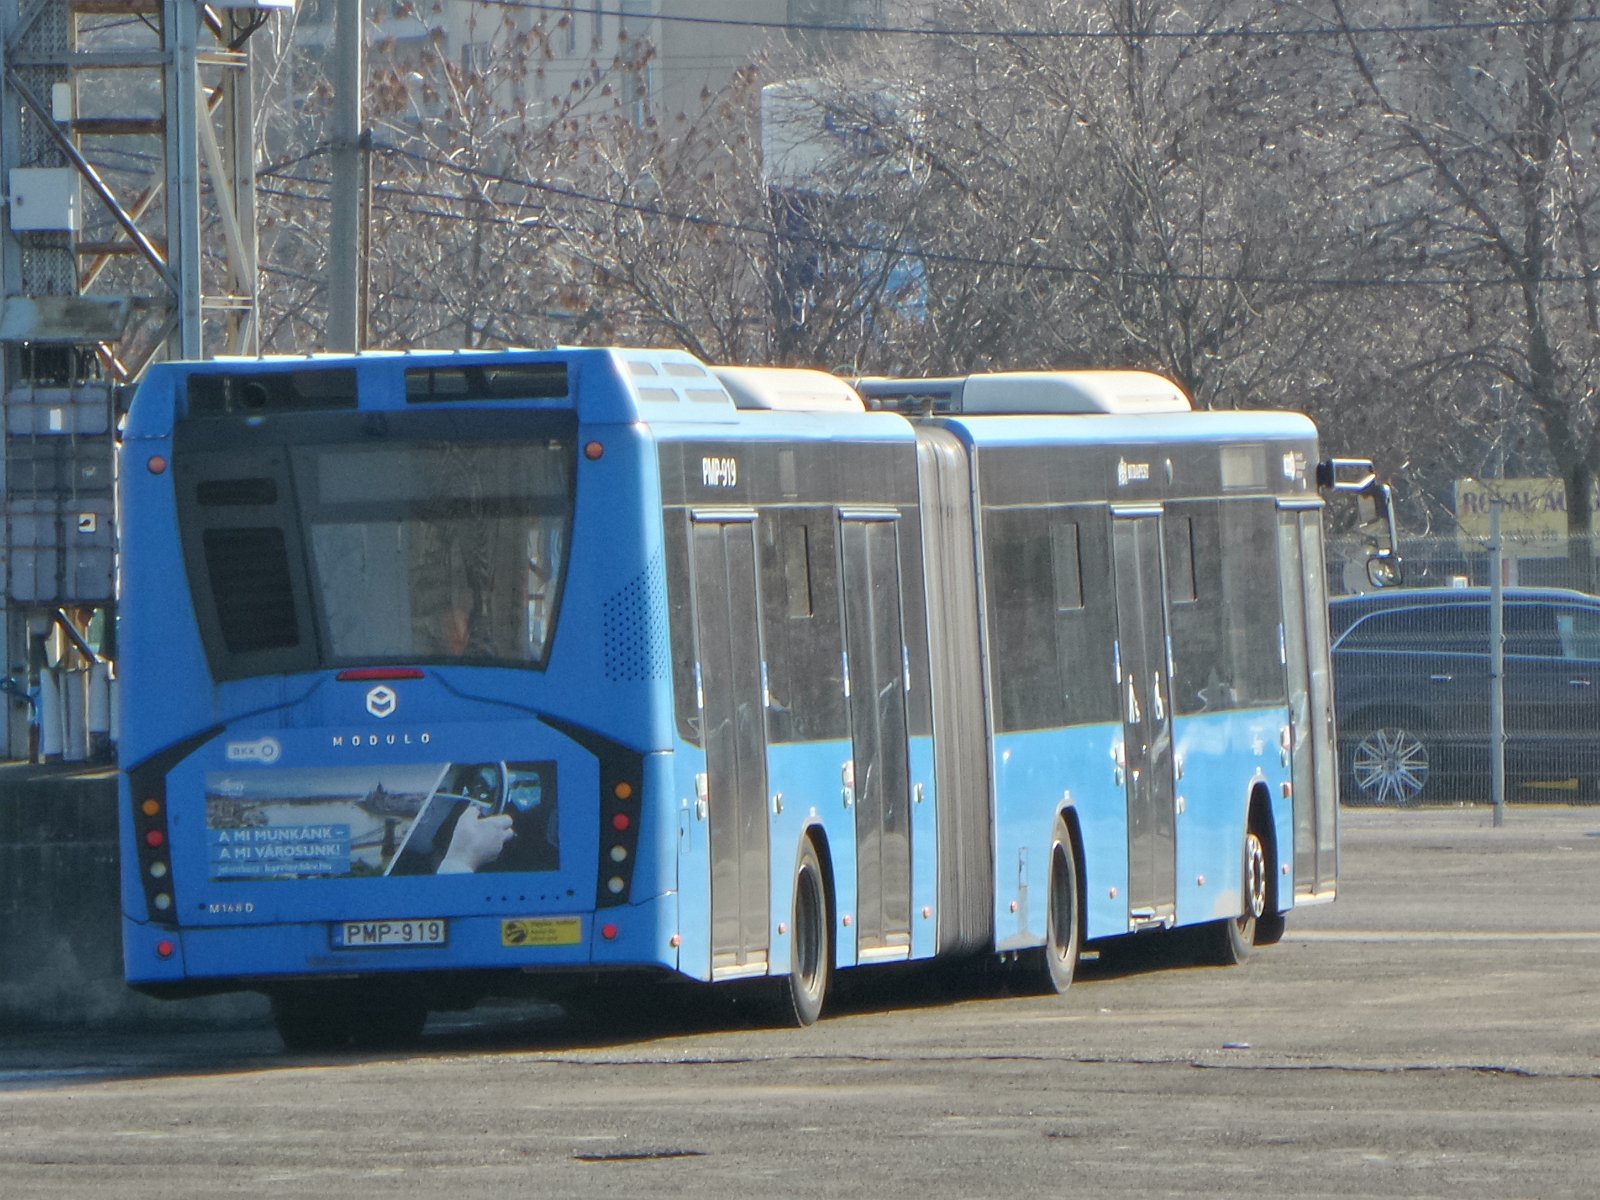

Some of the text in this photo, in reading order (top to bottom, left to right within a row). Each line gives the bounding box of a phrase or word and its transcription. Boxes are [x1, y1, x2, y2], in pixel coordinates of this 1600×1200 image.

[702, 457, 737, 487] PMP-919
[333, 733, 430, 747] MODULO
[219, 831, 230, 842] A
[234, 830, 251, 842] MI
[220, 847, 231, 859] A
[234, 846, 251, 858] MI
[347, 922, 440, 943] PMP-919
